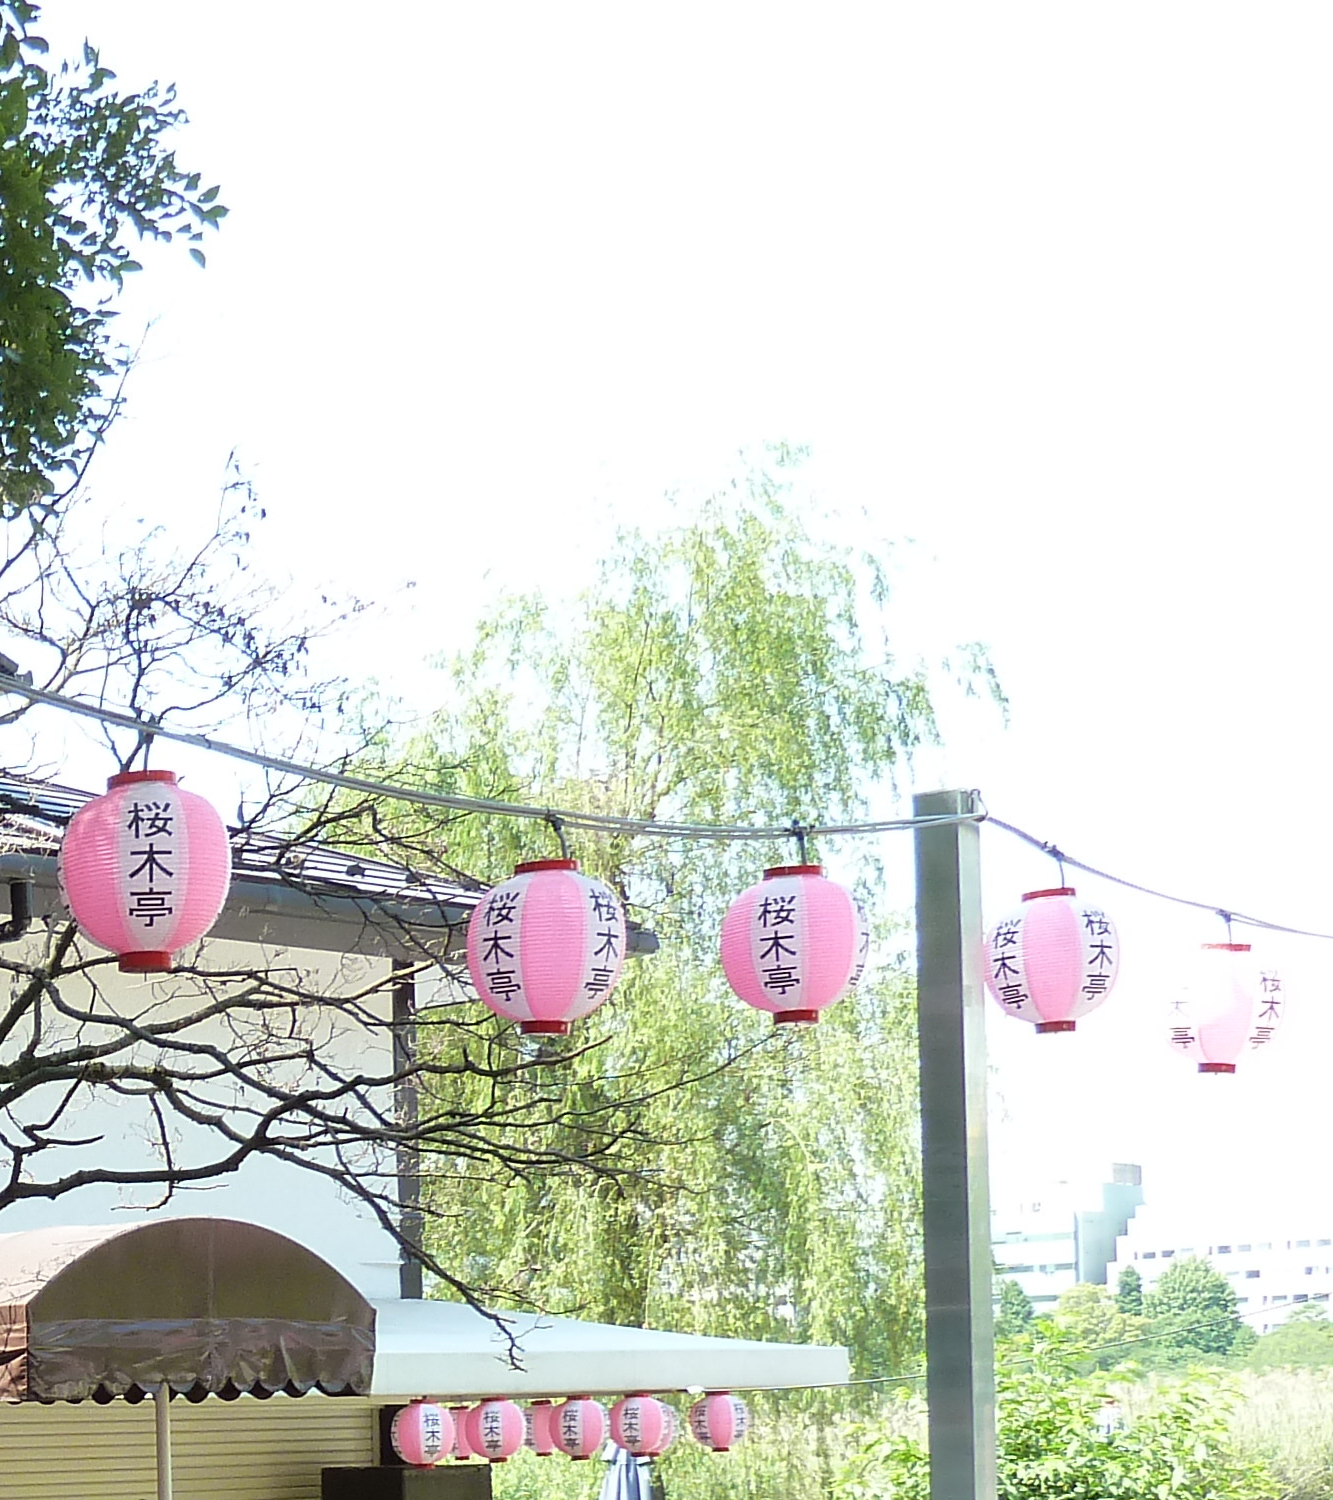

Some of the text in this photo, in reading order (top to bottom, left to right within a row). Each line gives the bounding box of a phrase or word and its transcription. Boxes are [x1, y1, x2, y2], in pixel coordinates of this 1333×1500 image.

[127, 802, 174, 928] 桜木亭
[483, 891, 521, 1002] 桜木亭
[584, 888, 619, 1000] 桜木亭
[758, 895, 801, 996] 桜木亭
[993, 919, 1028, 1009] 桜木亭
[1082, 910, 1113, 1000] 桜木亭
[424, 1413, 441, 1457] 桜木亭
[483, 1411, 502, 1451] 桜木亭
